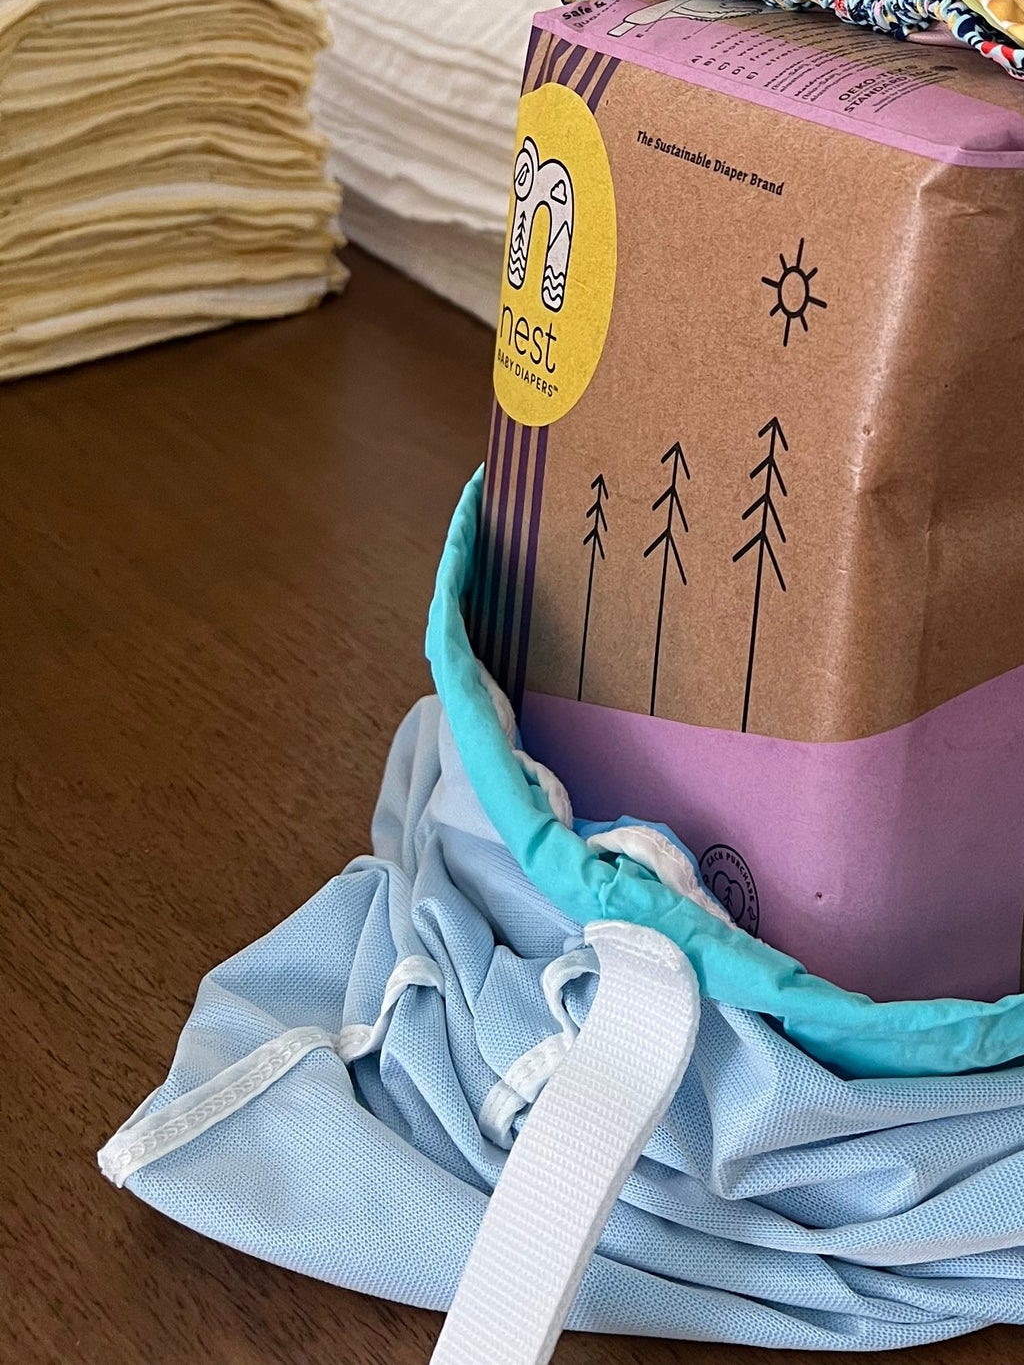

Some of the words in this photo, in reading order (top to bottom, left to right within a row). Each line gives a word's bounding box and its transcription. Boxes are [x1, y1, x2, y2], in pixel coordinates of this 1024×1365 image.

[636, 130, 653, 147] The
[654, 138, 712, 169] Sustainable
[713, 159, 749, 183] Diaper
[750, 172, 785, 196] Brand
[497, 348, 514, 371] BABY
[500, 304, 557, 374] nest
